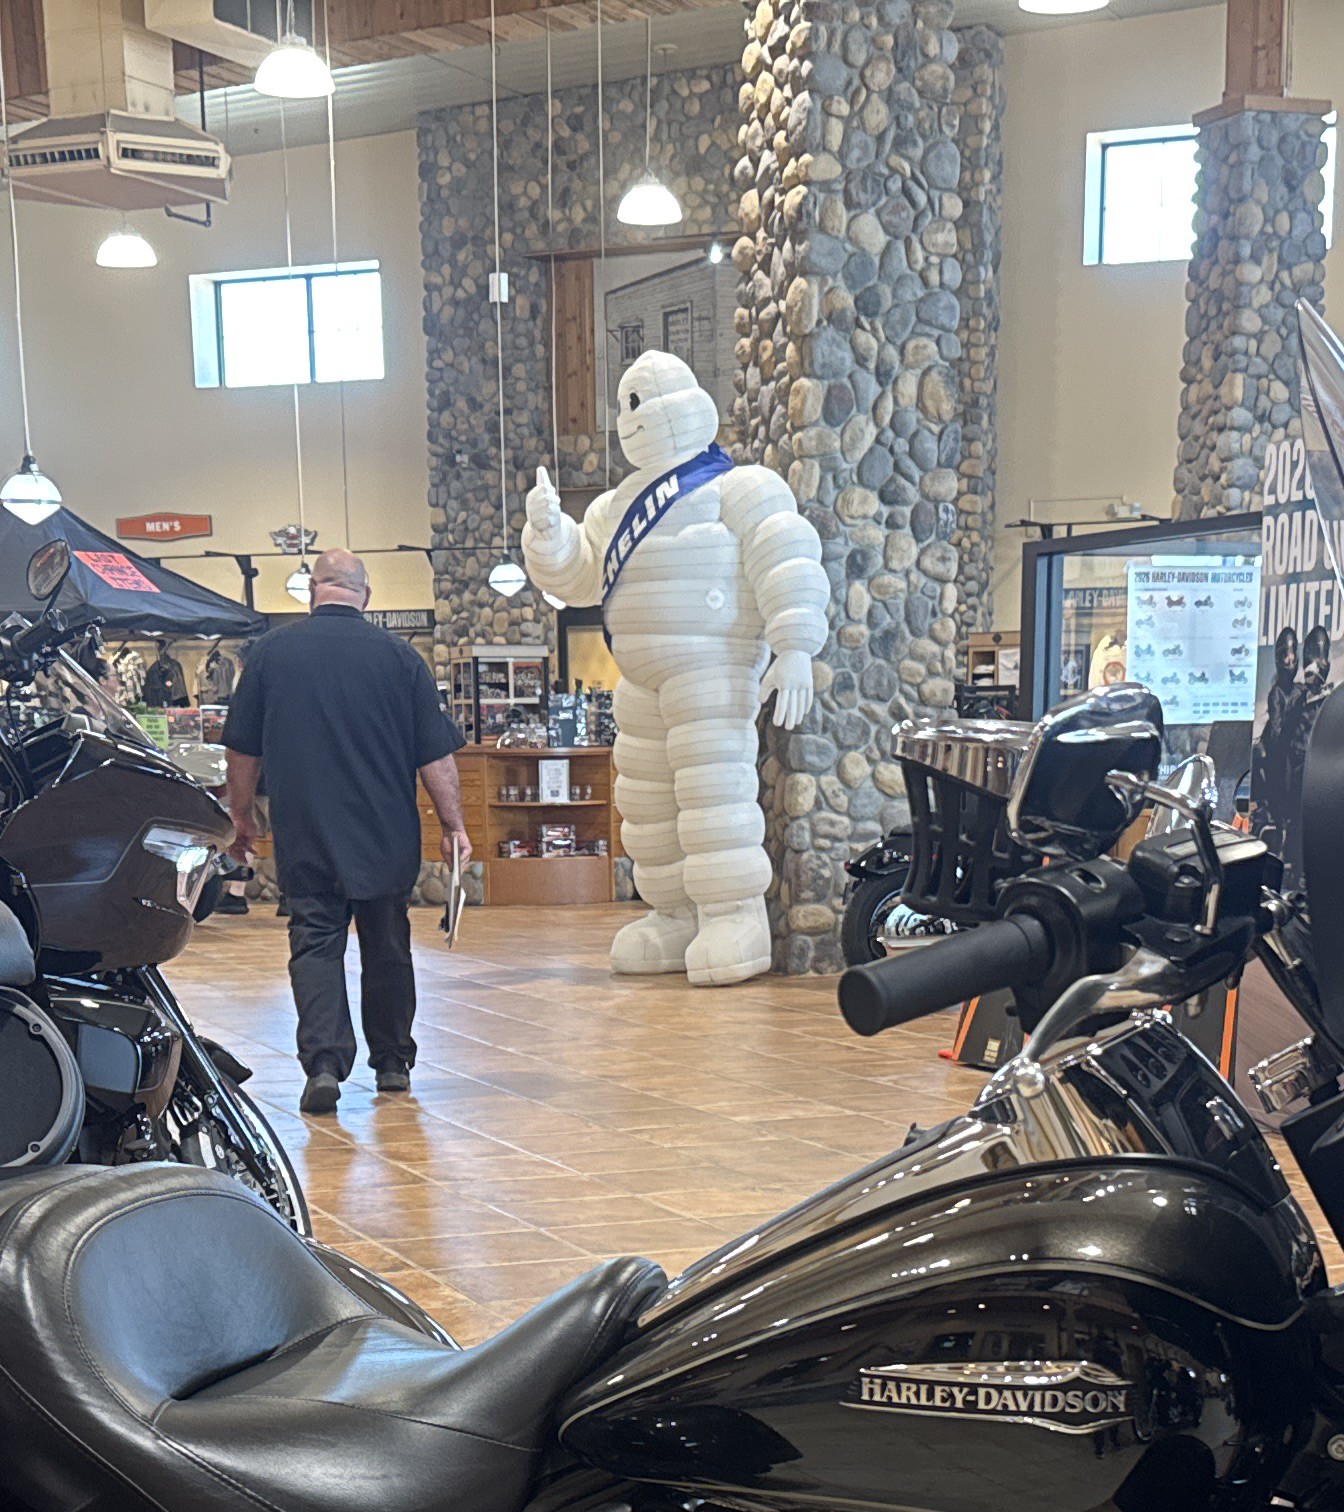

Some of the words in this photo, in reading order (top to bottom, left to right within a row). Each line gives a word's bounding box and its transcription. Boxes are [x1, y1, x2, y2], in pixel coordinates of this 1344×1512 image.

[145, 520, 182, 533] MEN'S
[601, 473, 681, 597] HELIN
[1262, 510, 1319, 577] ROAD
[1151, 571, 1209, 584] HARLEY-DAVIDSON
[364, 611, 428, 628] RLEY-DAVIDSON
[860, 1376, 1127, 1414] HARLEY-DAVIDSON
